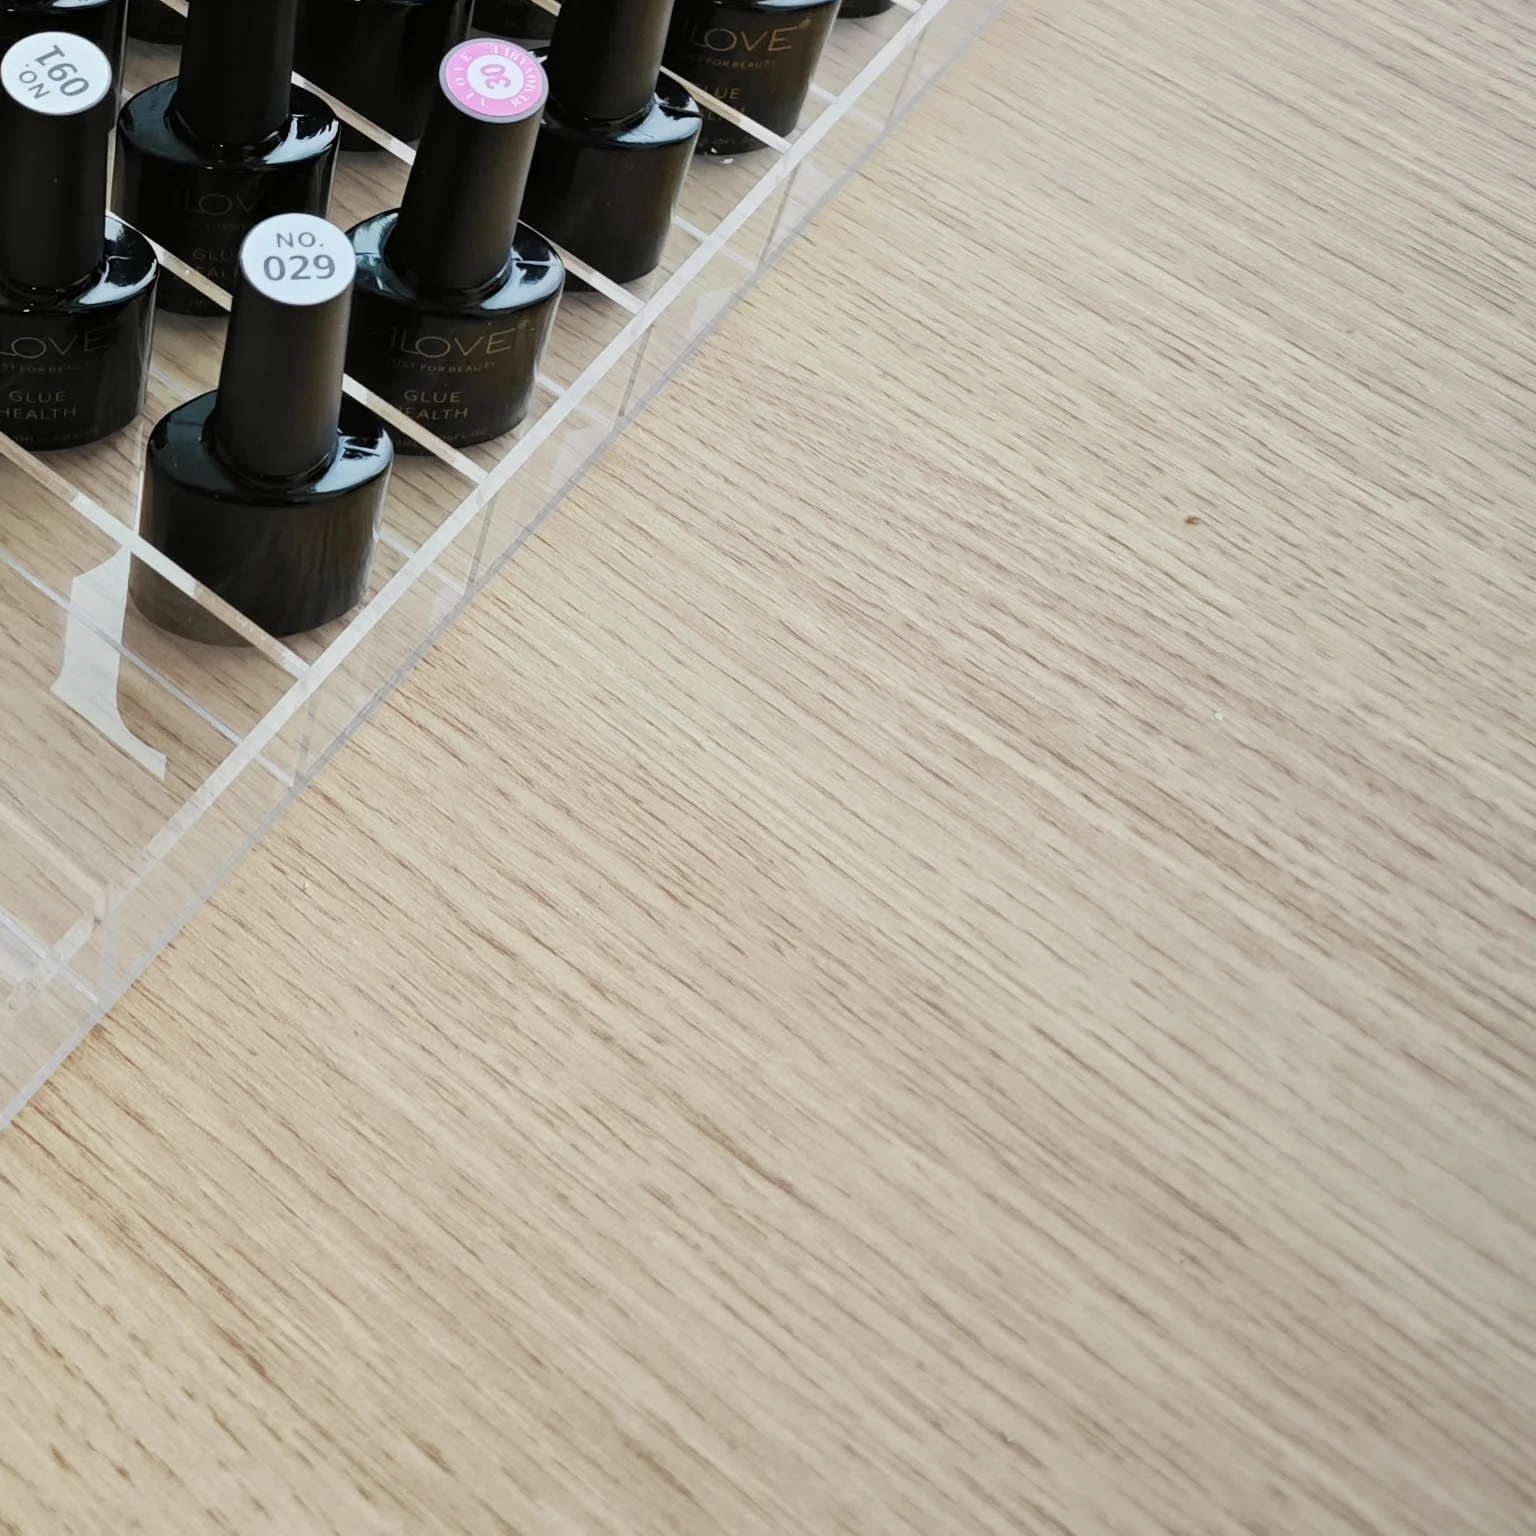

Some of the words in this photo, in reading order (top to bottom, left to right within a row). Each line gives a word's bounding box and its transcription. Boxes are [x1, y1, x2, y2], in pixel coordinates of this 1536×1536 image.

[20, 63, 52, 101] NO.
[34, 44, 90, 98] 091
[452, 52, 487, 109] ALOVE
[479, 64, 512, 91] 30
[492, 46, 537, 108] REMOVABLE
[276, 232, 324, 249] NO.
[262, 255, 336, 281] 029
[9, 390, 66, 403] GLUE
[404, 390, 462, 403] GLUE
